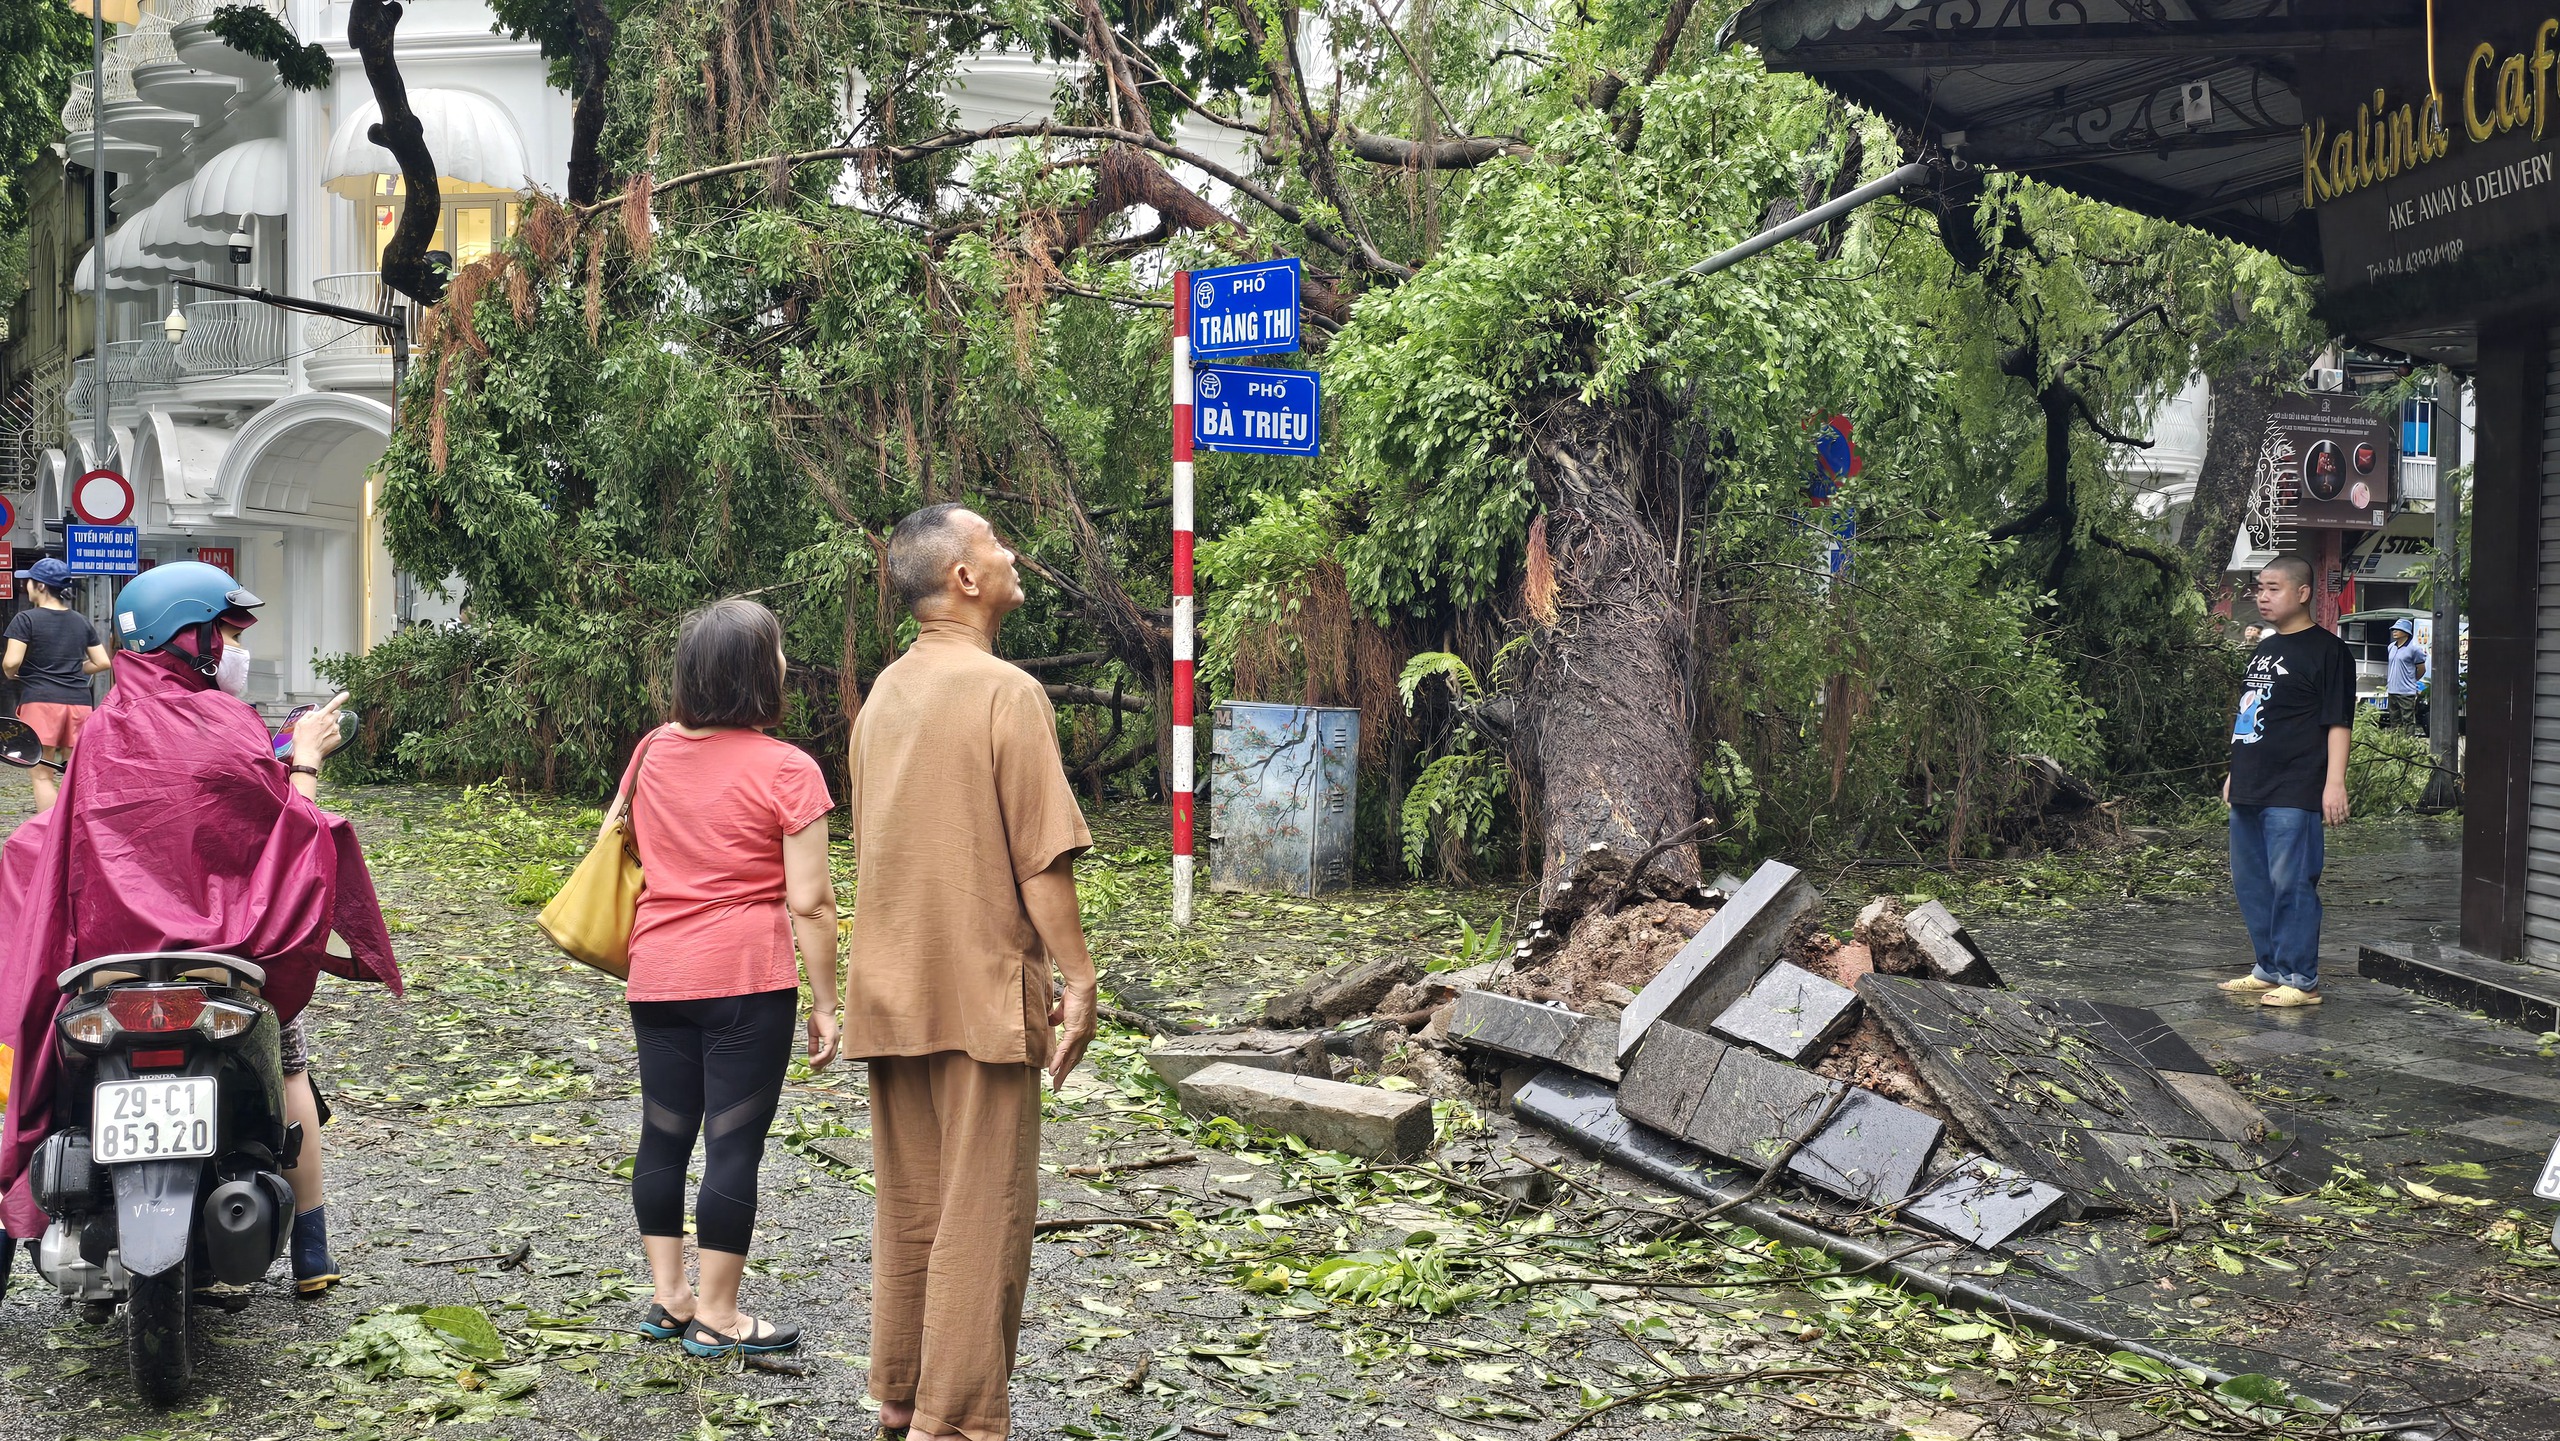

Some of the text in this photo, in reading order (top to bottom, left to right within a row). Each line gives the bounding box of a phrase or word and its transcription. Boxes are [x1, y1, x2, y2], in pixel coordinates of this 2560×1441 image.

[2301, 18, 2560, 208] Kalina Caf
[2388, 152, 2554, 232] AKE AWAY & DELIVERY
[1233, 271, 1266, 295] PHỐ
[1200, 307, 1291, 345] TRÀNG THI
[1248, 379, 1288, 398] PHỐ
[1203, 401, 1308, 445] BÀ TRIỆU
[99, 530, 114, 544] PHỐ
[203, 551, 228, 564] UNI
[113, 1083, 195, 1120] 29-C1
[103, 1118, 208, 1158] 853.20
